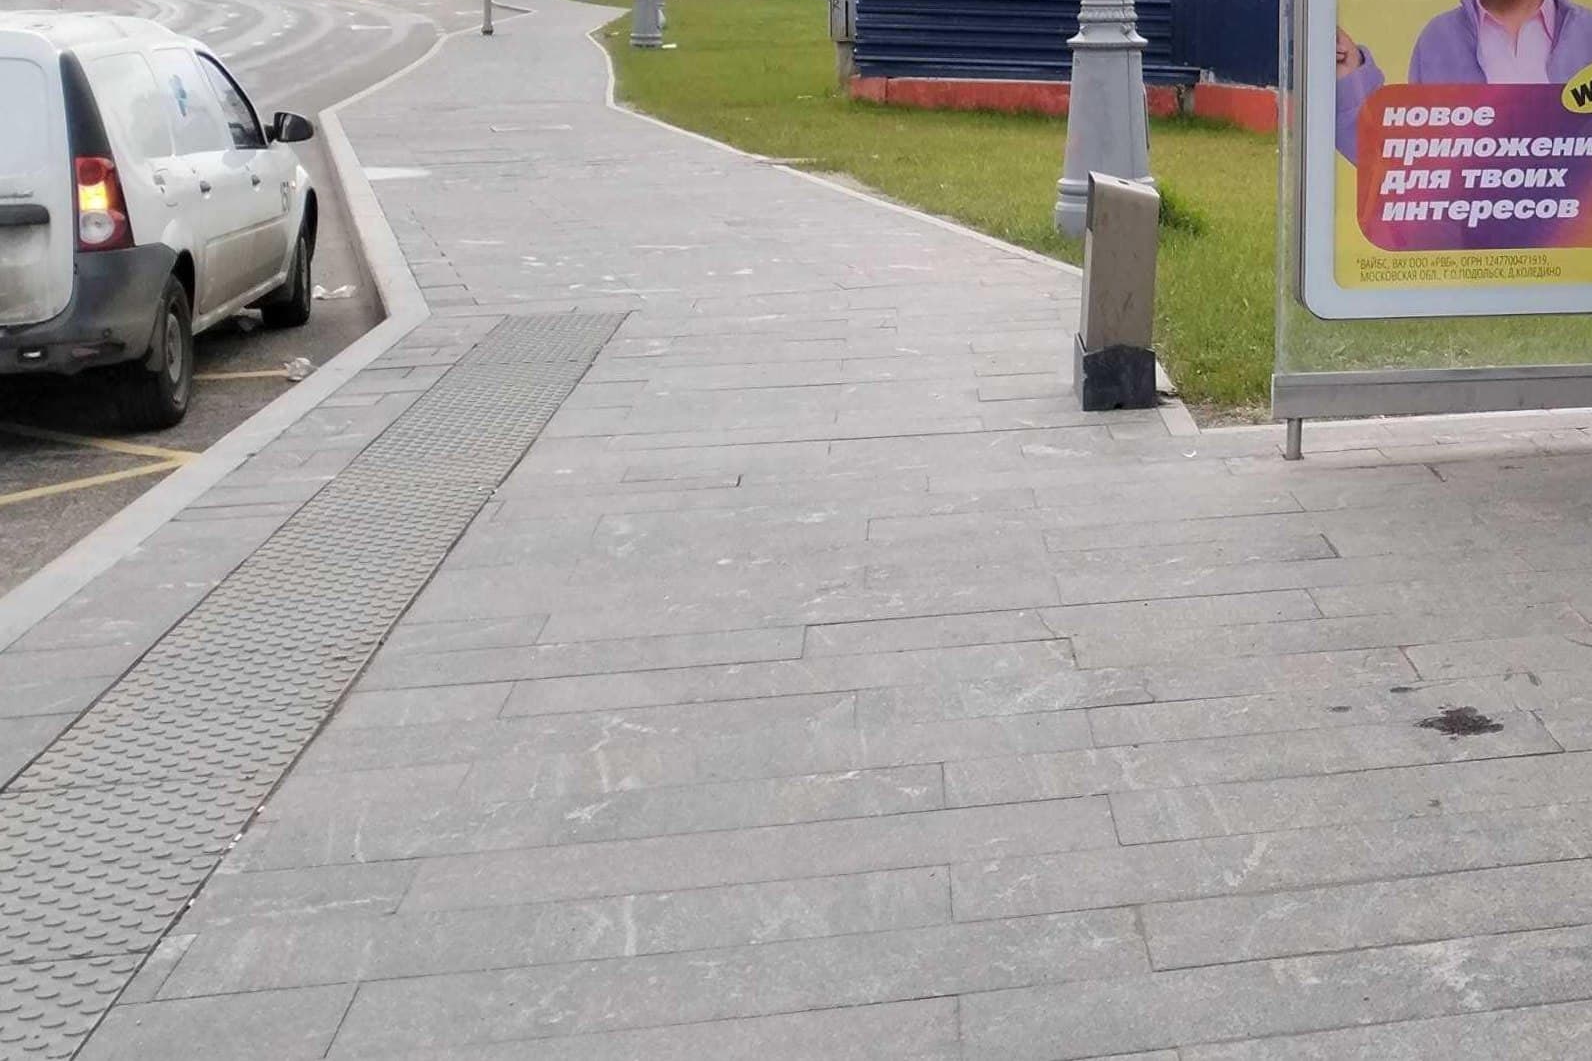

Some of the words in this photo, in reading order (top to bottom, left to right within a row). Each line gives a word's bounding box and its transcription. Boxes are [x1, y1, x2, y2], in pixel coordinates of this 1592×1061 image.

[1382, 106, 1496, 127] новое
[1380, 168, 1451, 195] для
[1461, 167, 1569, 189] твоих
[1381, 198, 1580, 228] интересов
